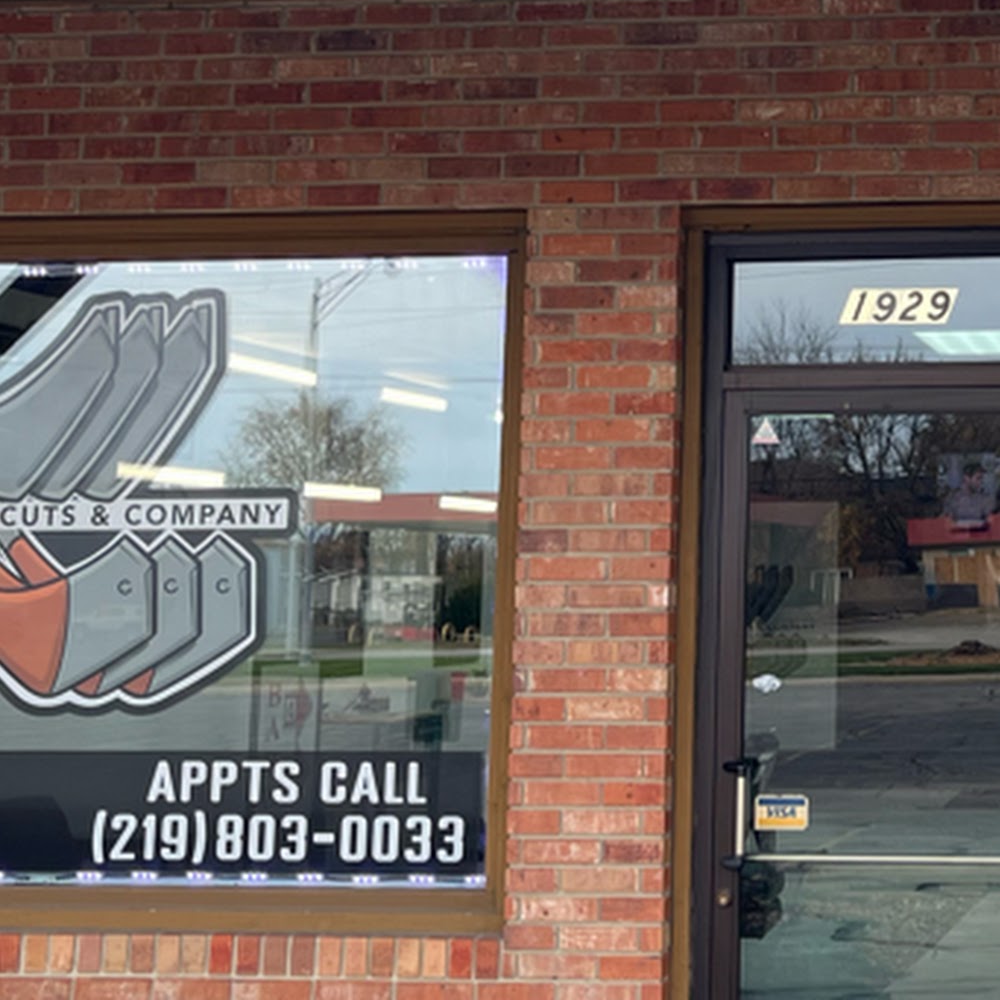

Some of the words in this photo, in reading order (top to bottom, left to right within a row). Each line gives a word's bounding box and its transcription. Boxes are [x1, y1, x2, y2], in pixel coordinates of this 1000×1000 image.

[852, 290, 952, 322] 1929
[0, 504, 76, 527] CUTS
[90, 505, 110, 526] &
[124, 502, 282, 527] COMPANY
[146, 760, 301, 804] APPTS
[319, 762, 428, 804] CALL
[767, 806, 797, 817] VISA
[91, 810, 466, 865] (219)803-0033
